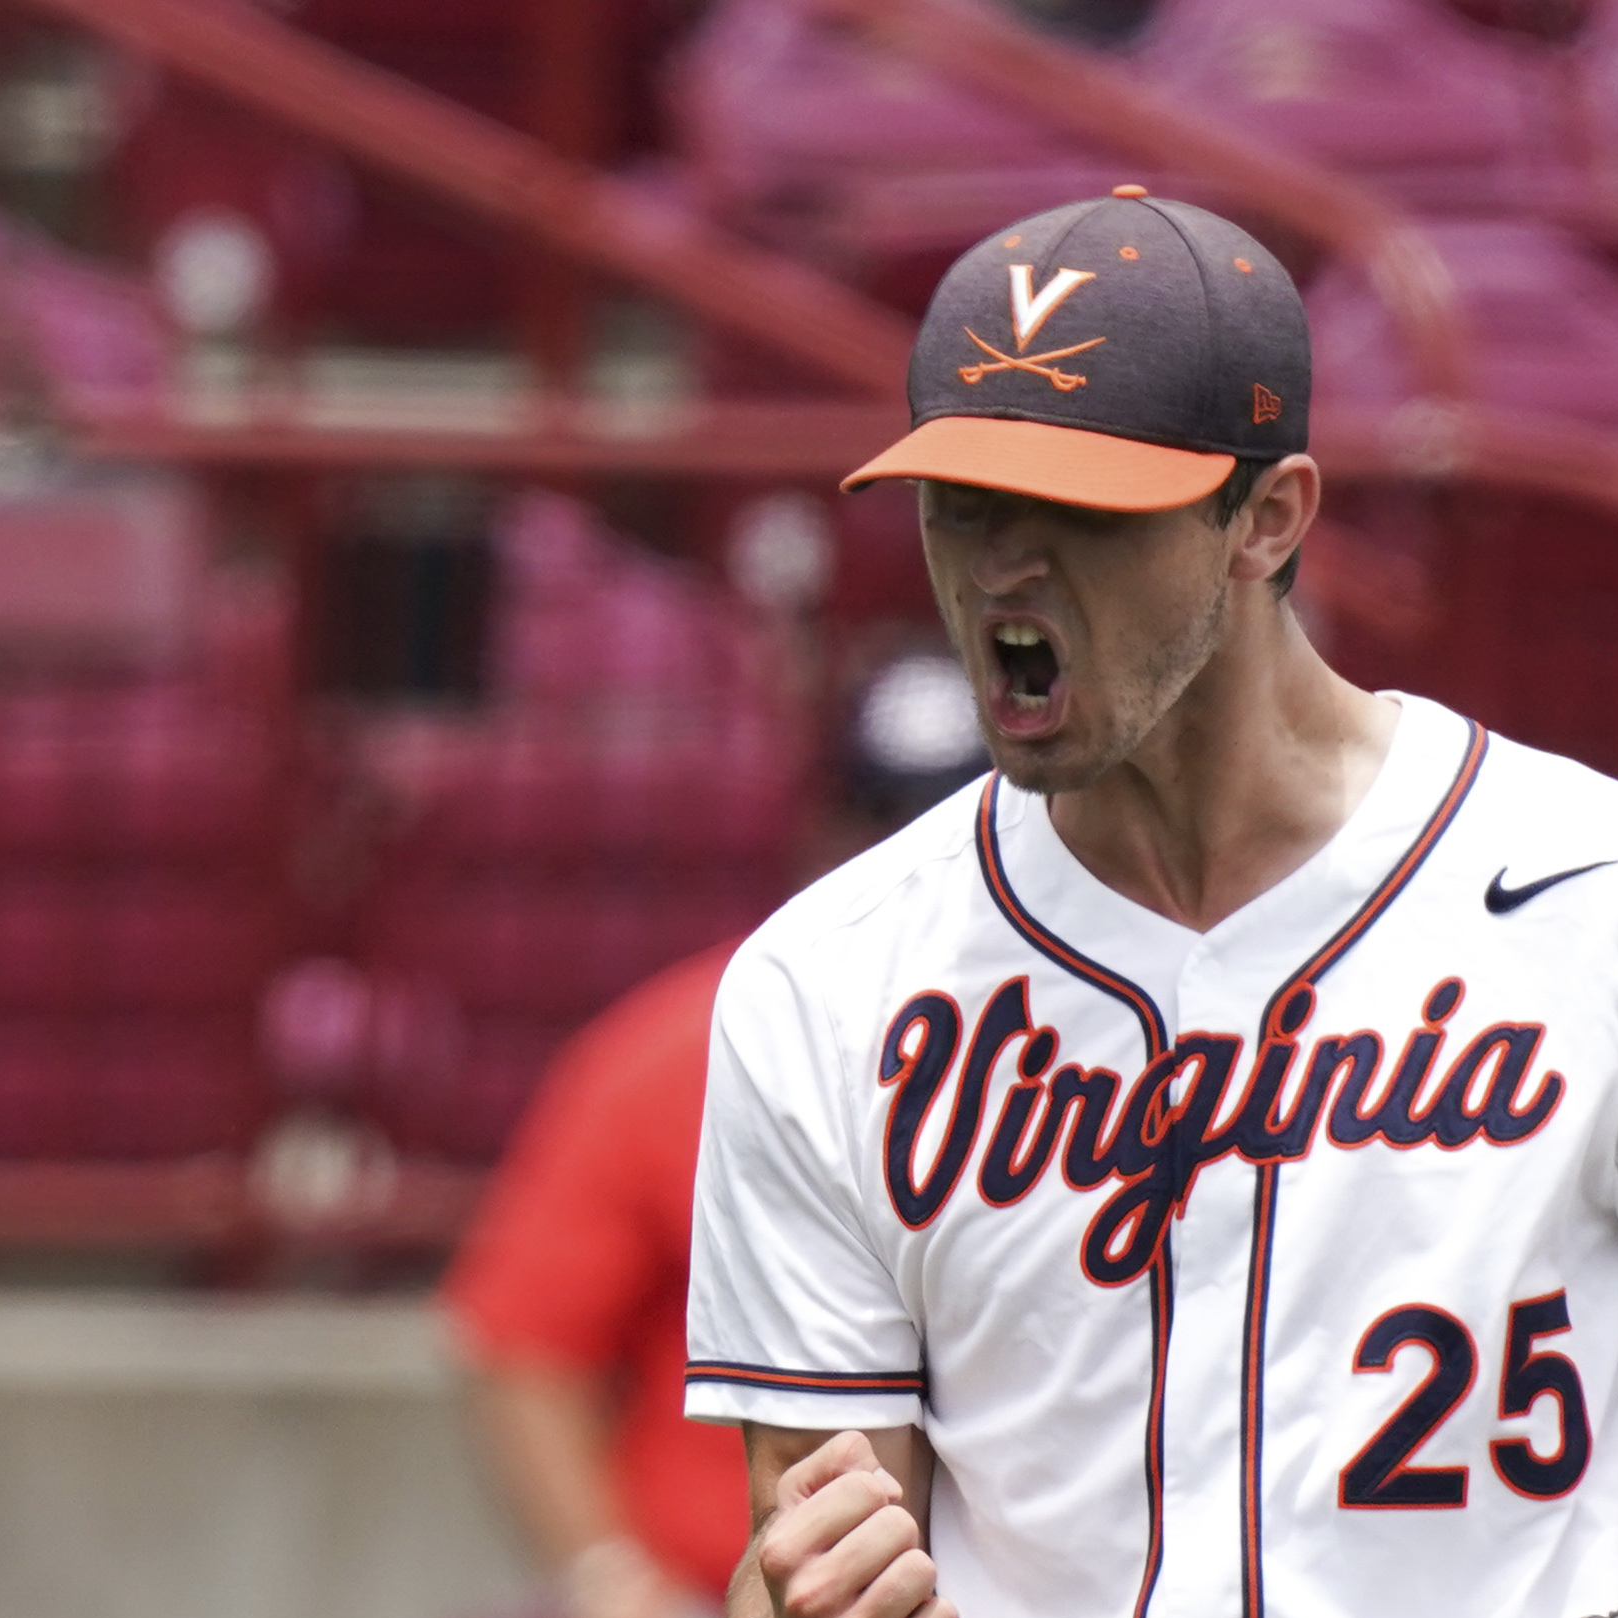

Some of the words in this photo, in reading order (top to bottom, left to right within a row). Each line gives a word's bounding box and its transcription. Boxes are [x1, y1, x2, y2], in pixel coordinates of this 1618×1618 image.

[1007, 263, 1098, 352] V
[880, 975, 1566, 1288] Virginia
[1338, 1288, 1593, 1510] 25
